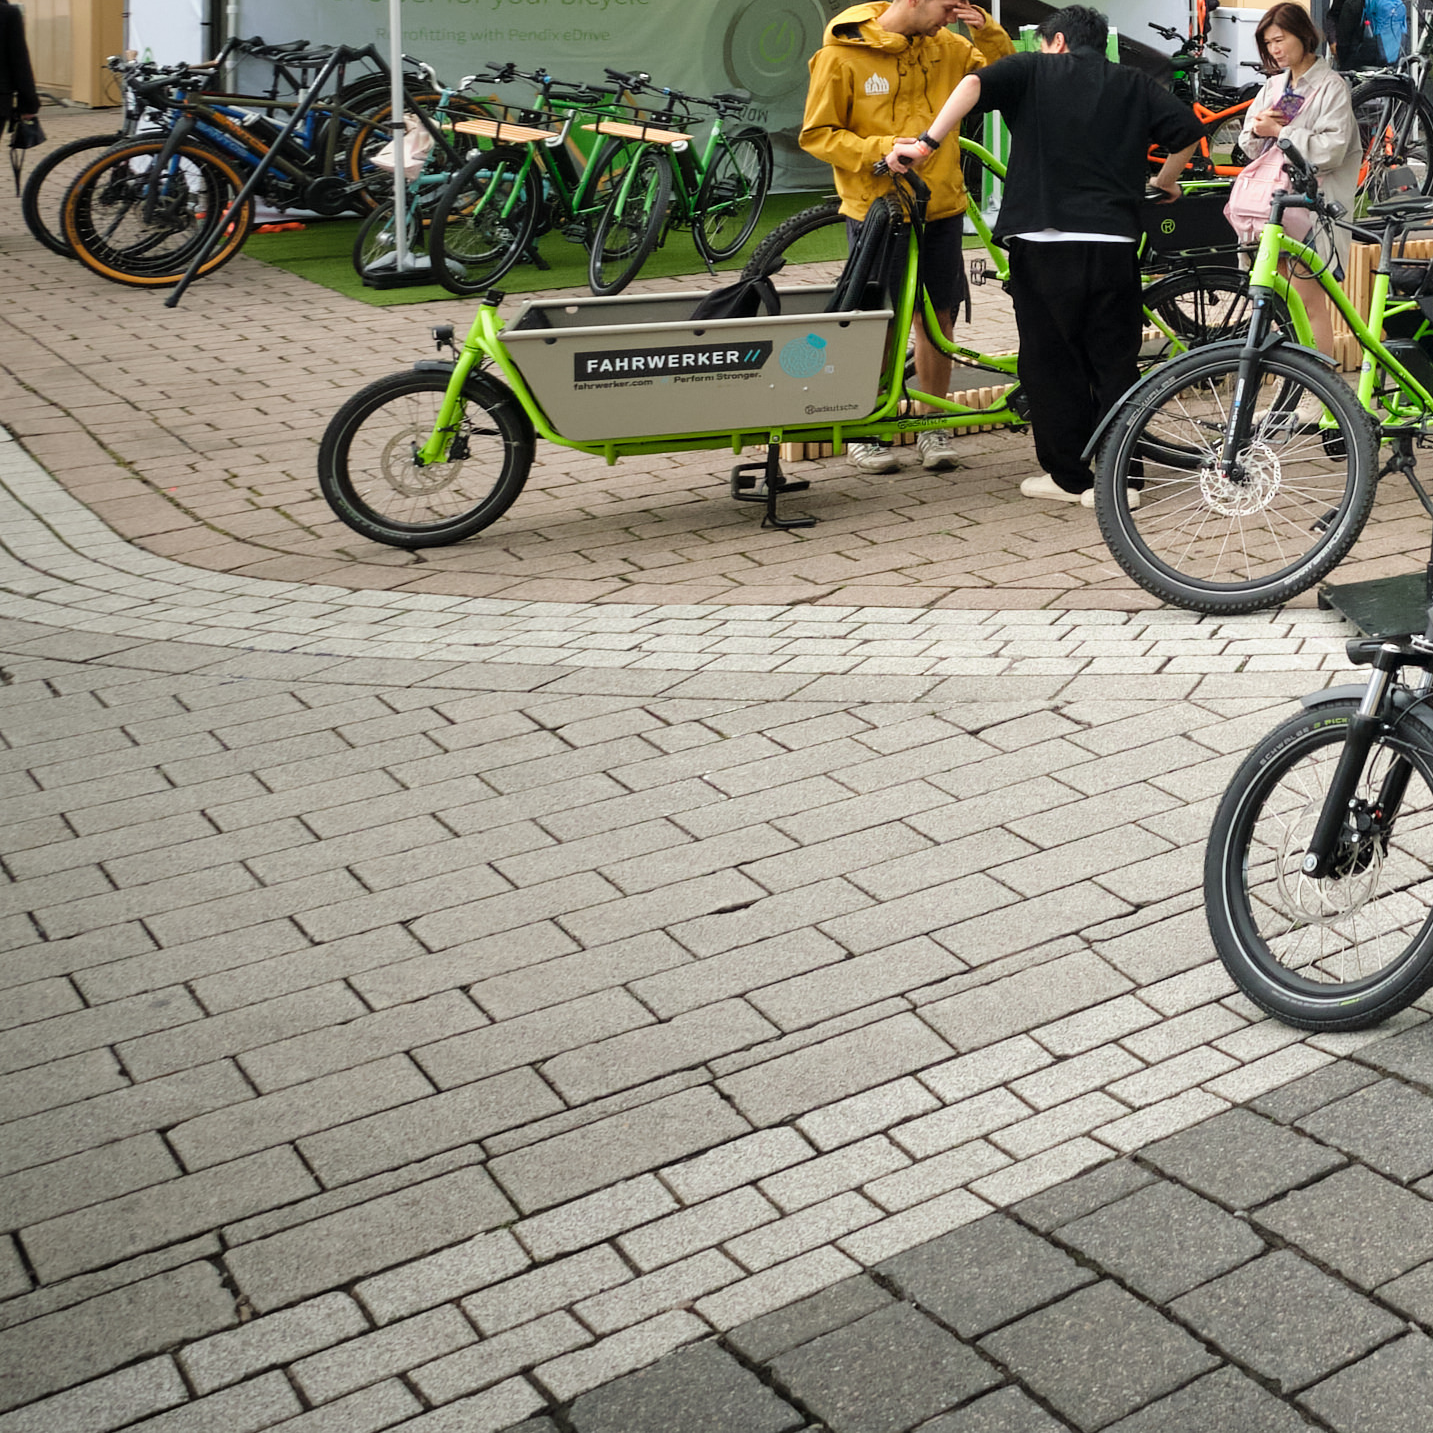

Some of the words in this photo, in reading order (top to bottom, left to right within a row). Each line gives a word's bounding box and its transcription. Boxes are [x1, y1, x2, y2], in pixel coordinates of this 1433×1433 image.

[586, 350, 740, 373] FAHRWERKER
[573, 378, 654, 391] fahrwerker.com
[673, 374, 715, 384] Perform
[716, 371, 762, 383] Stronger.
[1260, 727, 1310, 766] SCHWALBE
[1324, 717, 1350, 726] PICK
